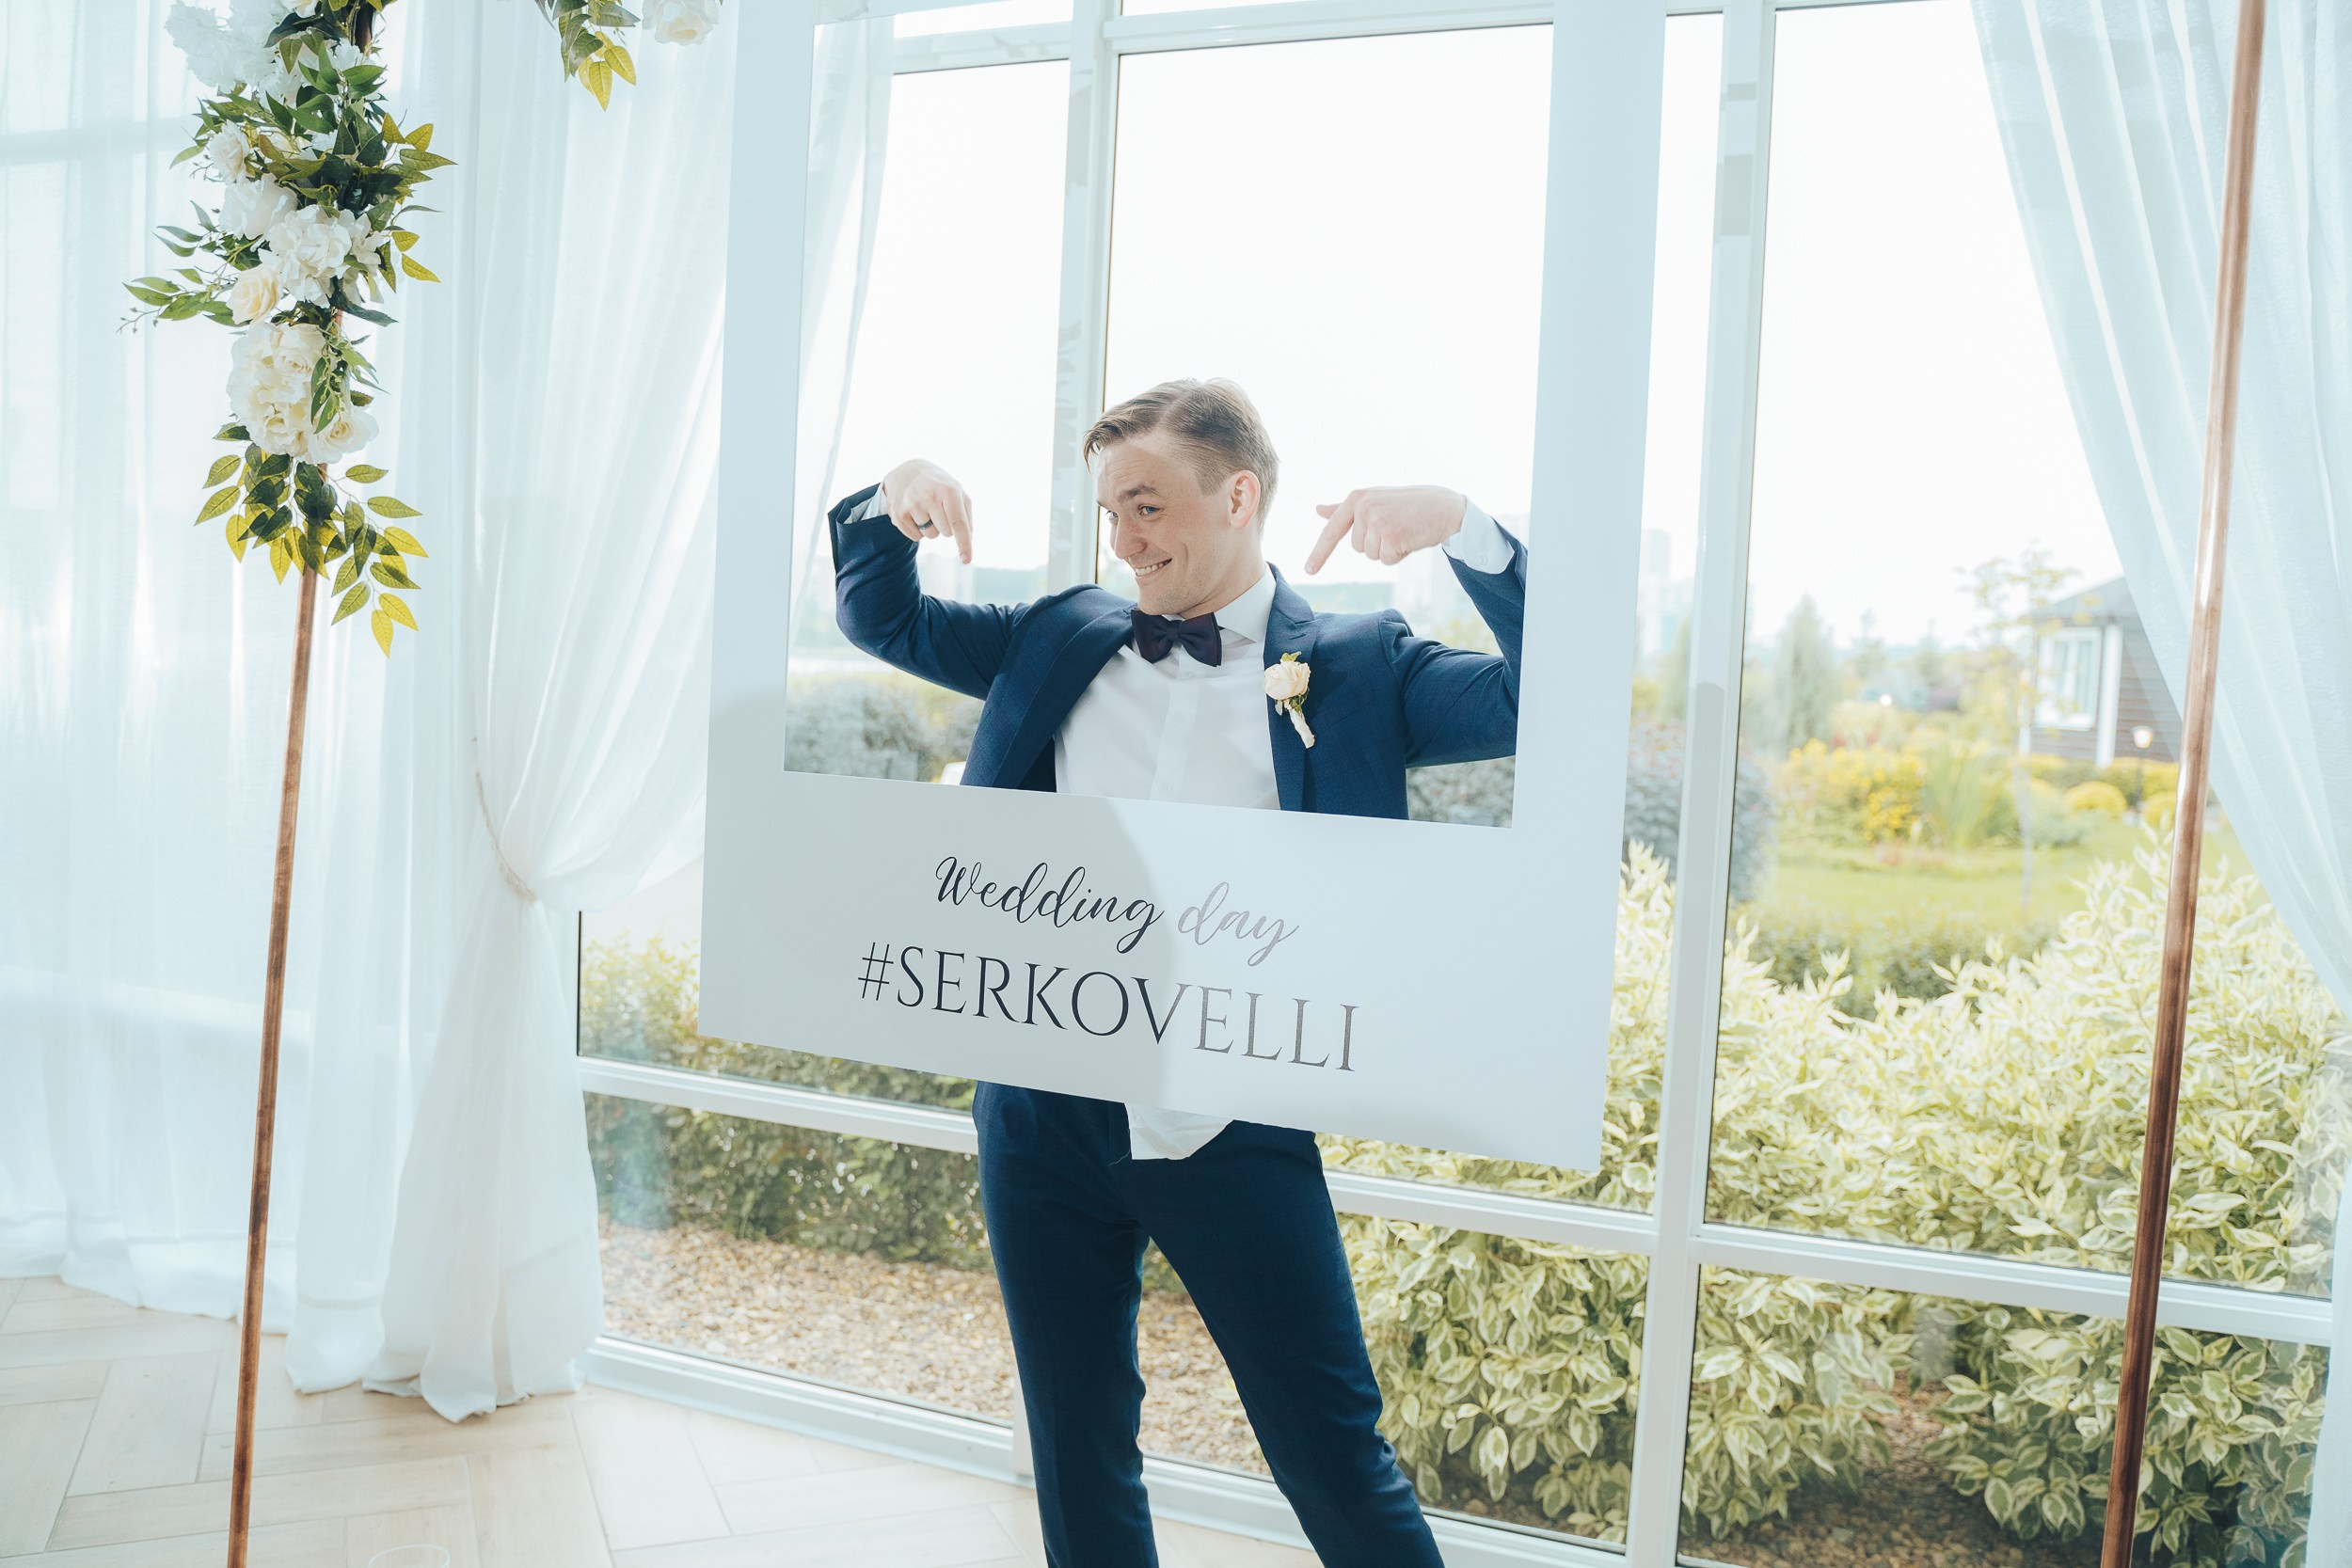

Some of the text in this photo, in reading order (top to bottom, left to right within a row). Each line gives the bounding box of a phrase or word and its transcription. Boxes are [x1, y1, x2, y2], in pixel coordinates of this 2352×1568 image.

[934, 855, 1299, 967] Wedding day
[857, 942, 1360, 1072] #SERKOVELLI
